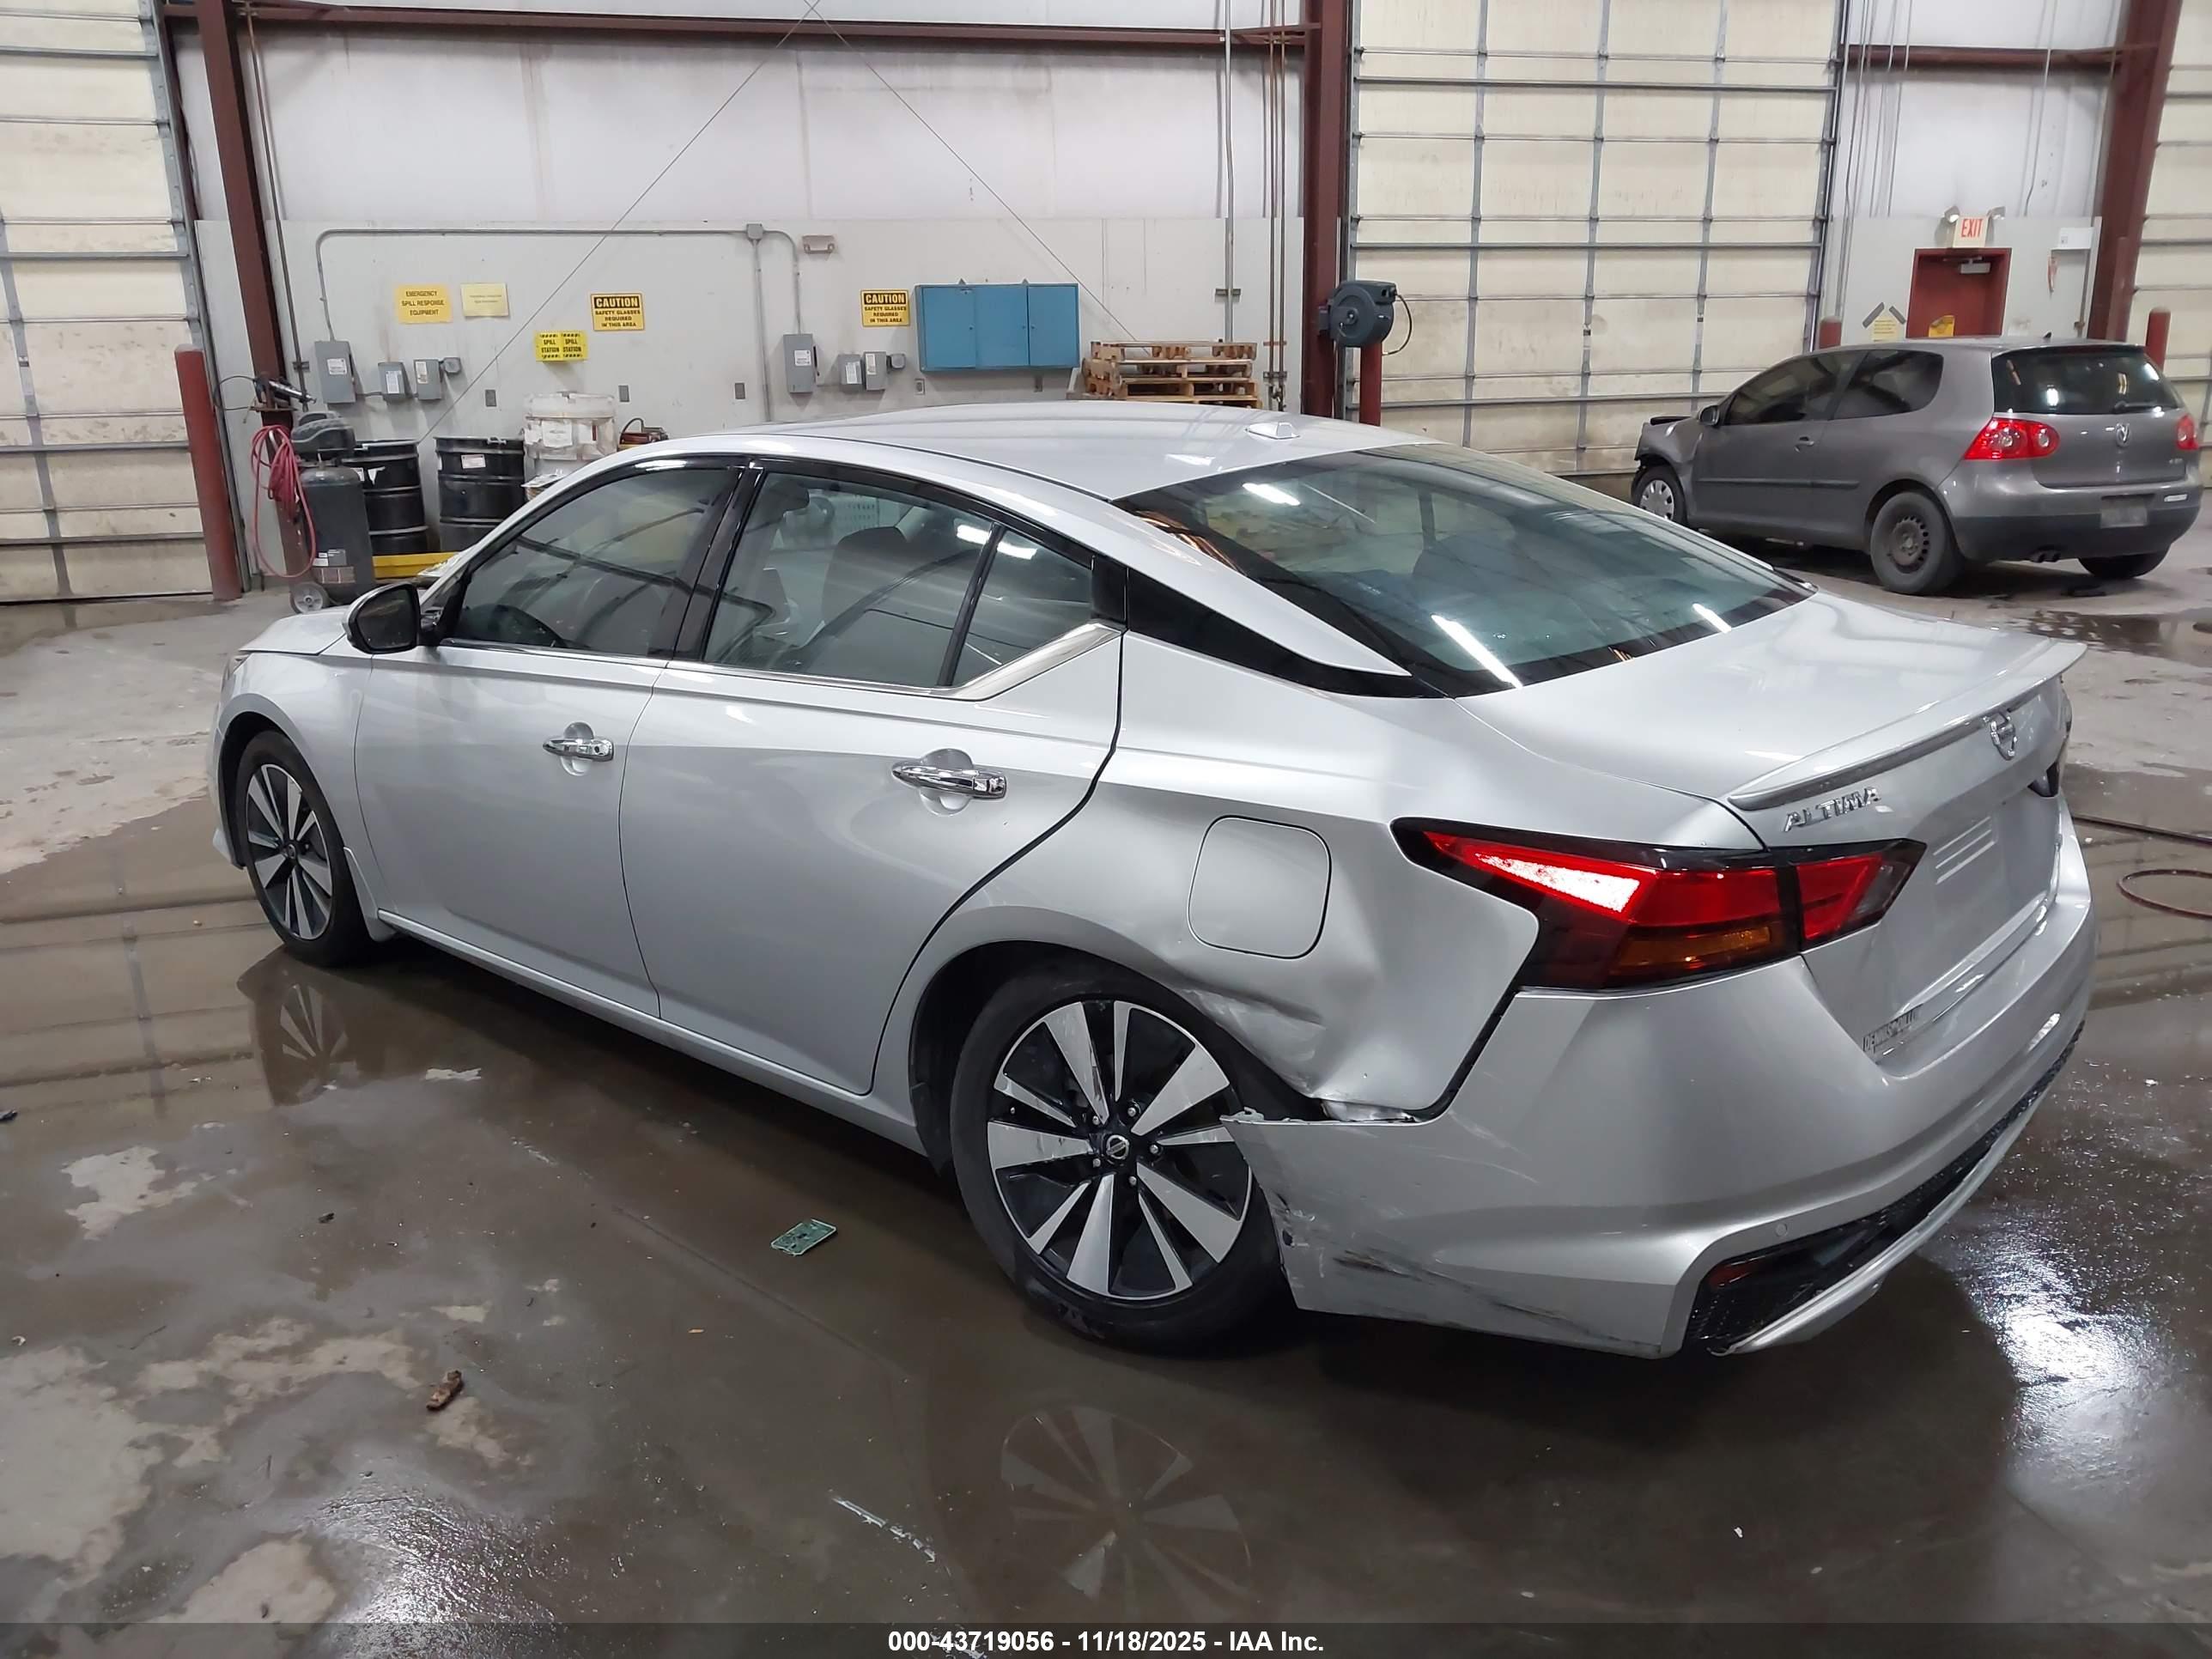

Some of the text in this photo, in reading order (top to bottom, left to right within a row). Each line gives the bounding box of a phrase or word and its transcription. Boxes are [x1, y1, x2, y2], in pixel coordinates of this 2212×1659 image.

[1961, 218, 1984, 238] EXIT
[596, 297, 638, 307] CAUTION
[866, 294, 905, 304] CAUTION
[1783, 787, 1881, 832] ALTIMA
